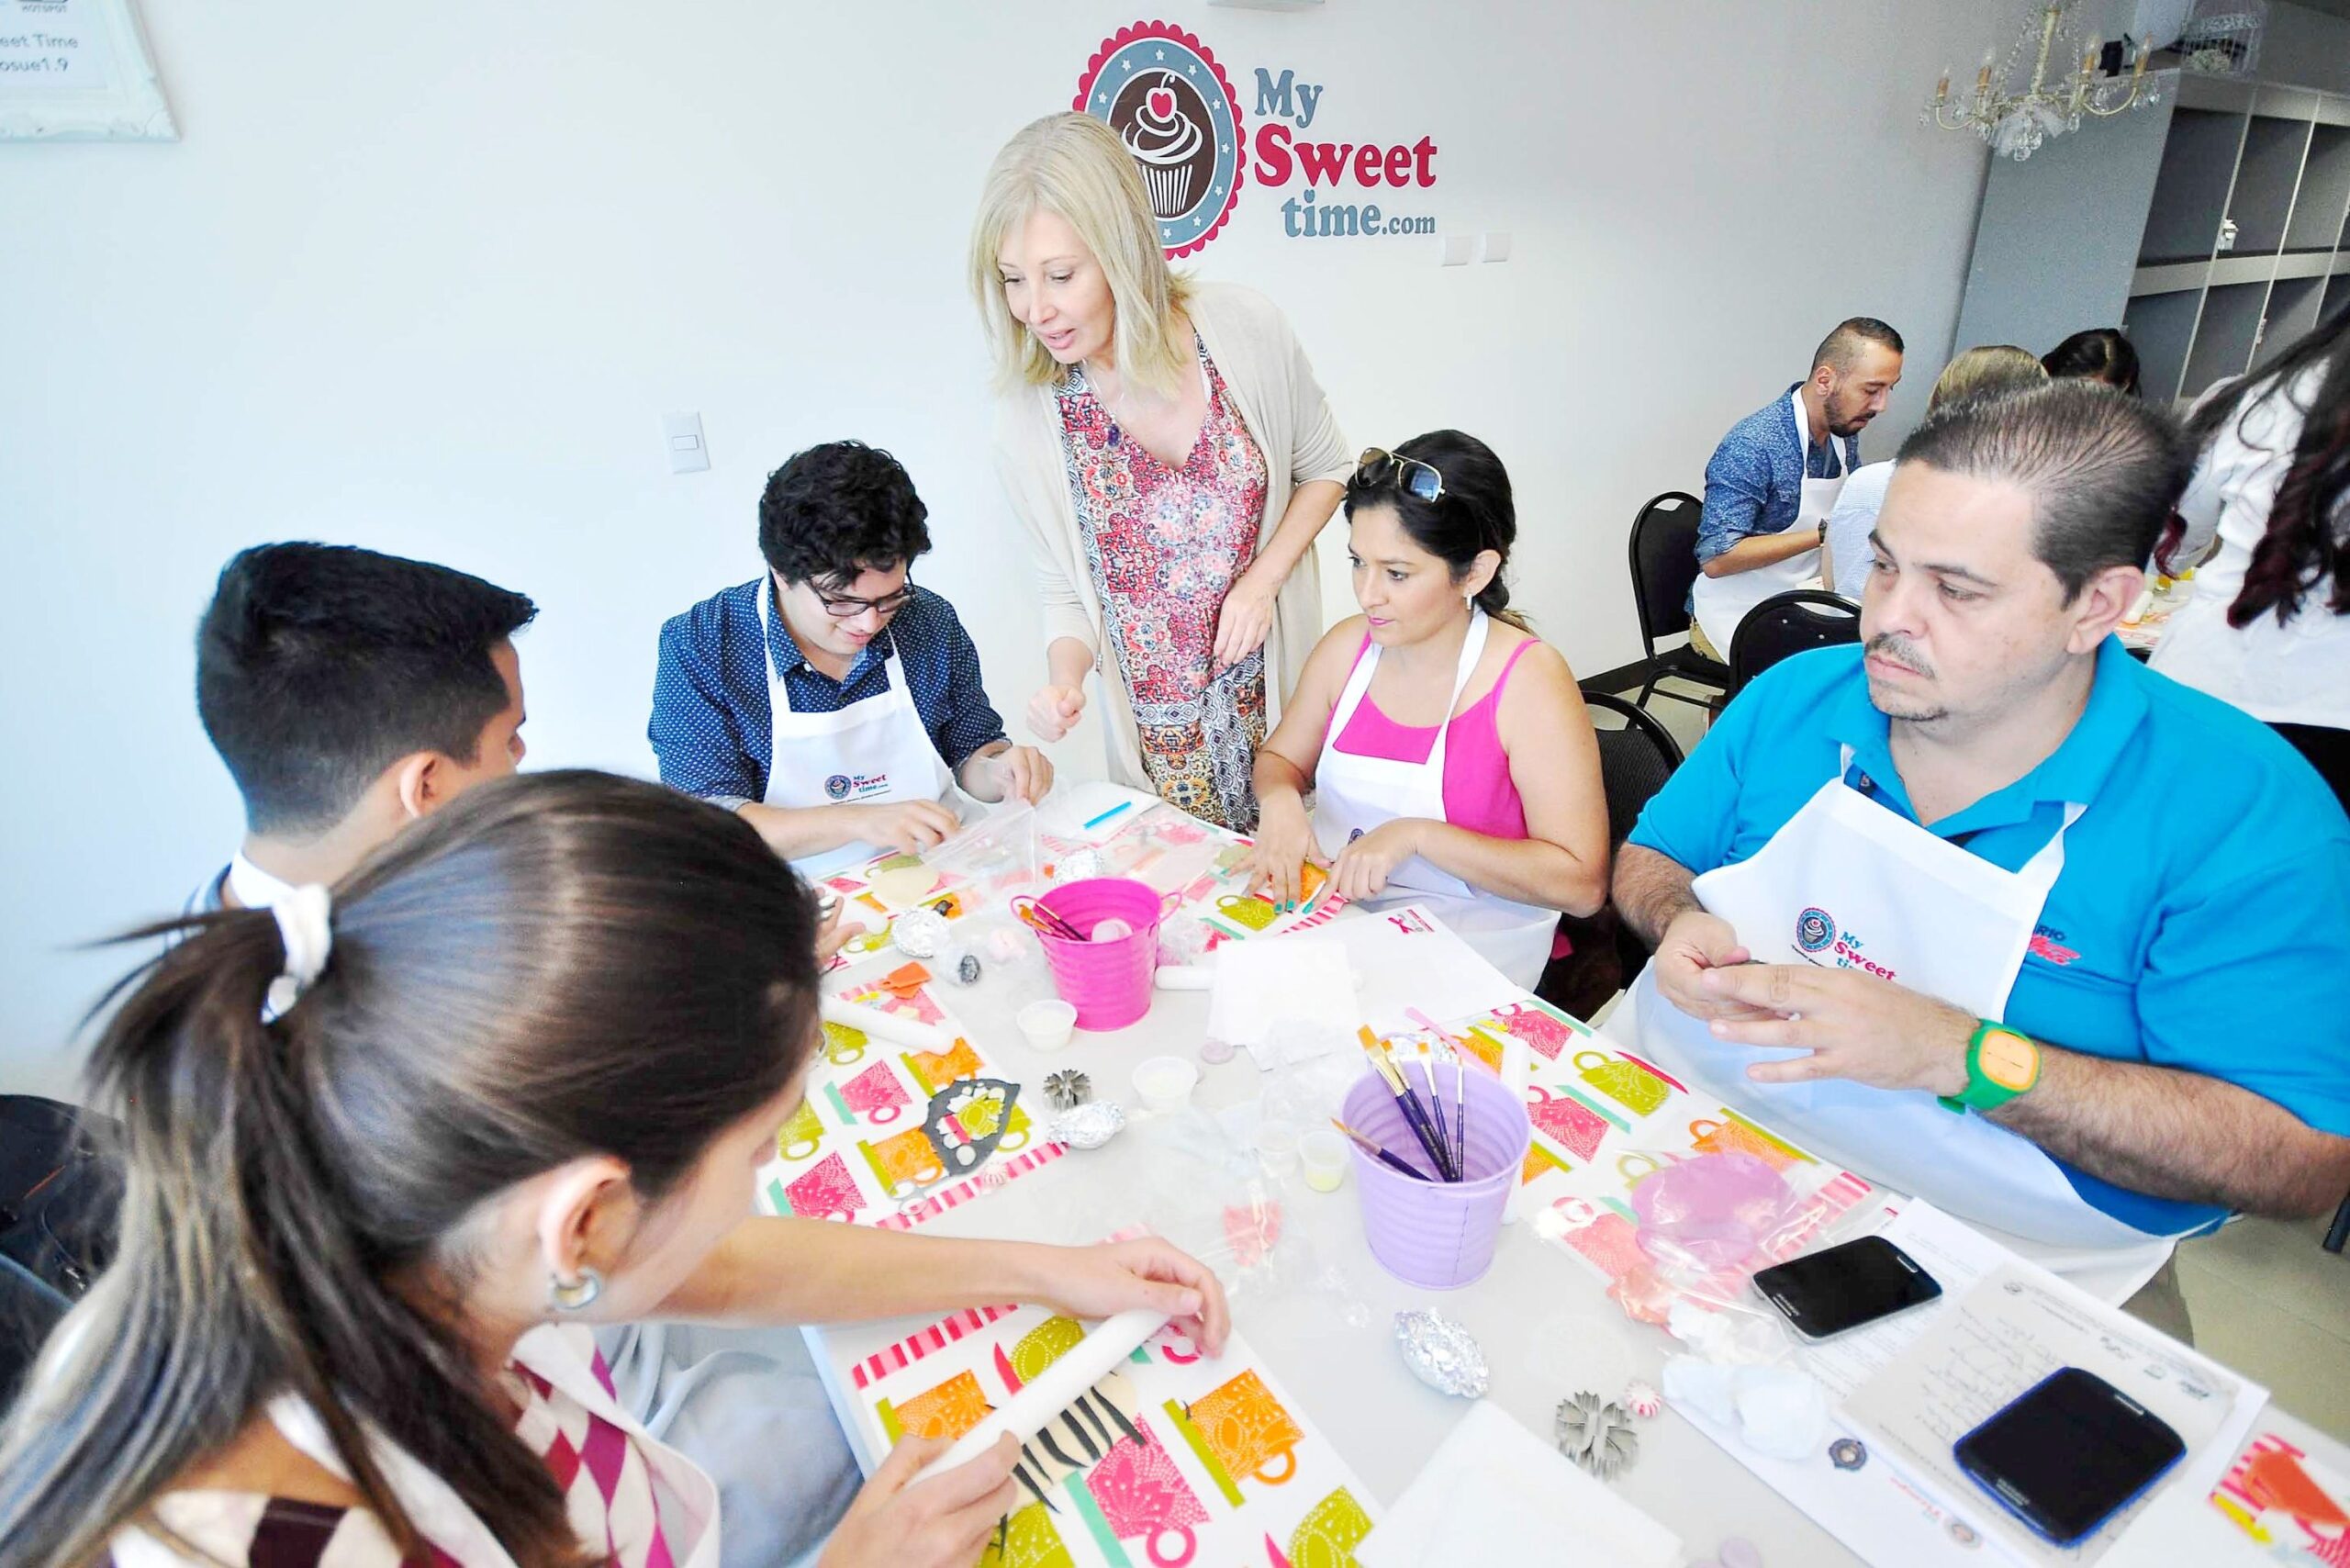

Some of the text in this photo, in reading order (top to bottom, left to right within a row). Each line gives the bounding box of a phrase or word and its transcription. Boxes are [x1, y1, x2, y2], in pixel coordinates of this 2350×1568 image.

[32, 34, 79, 48] Time
[1254, 67, 1324, 129] My
[1254, 123, 1438, 188] Sweet
[853, 774, 887, 788] Sweet
[1841, 931, 1864, 949] My
[1834, 941, 1897, 981] Sweet
